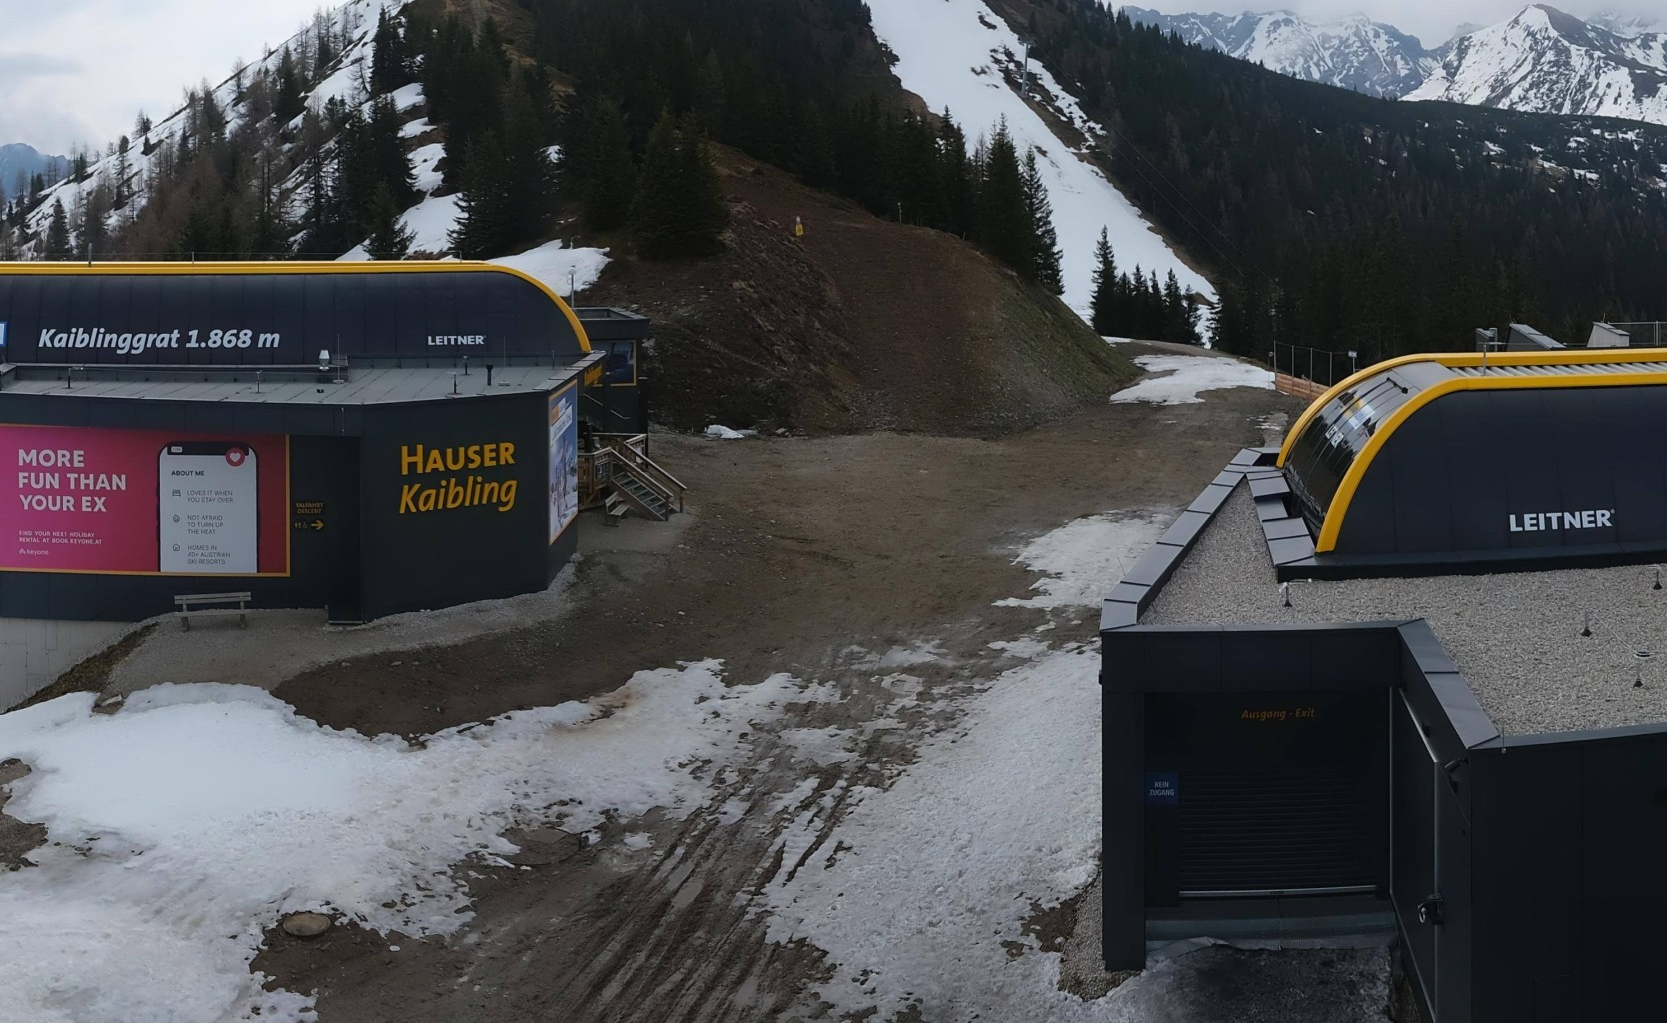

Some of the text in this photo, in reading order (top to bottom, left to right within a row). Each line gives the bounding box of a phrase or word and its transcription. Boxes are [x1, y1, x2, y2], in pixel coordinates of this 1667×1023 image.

[38, 327, 280, 354] Kaiblinggrat 1.868 m
[427, 335, 486, 346] LEITNER
[18, 449, 85, 467] MORE
[401, 442, 516, 475] HAUSER
[18, 472, 127, 490] FUN THAN
[19, 494, 107, 512] YOUR EX
[399, 476, 518, 514] Kaibling
[1509, 509, 1613, 532] LEITNER
[27, 548, 49, 556] keyone
[1241, 709, 1287, 722] Ausgang
[1295, 707, 1316, 718] Exit
